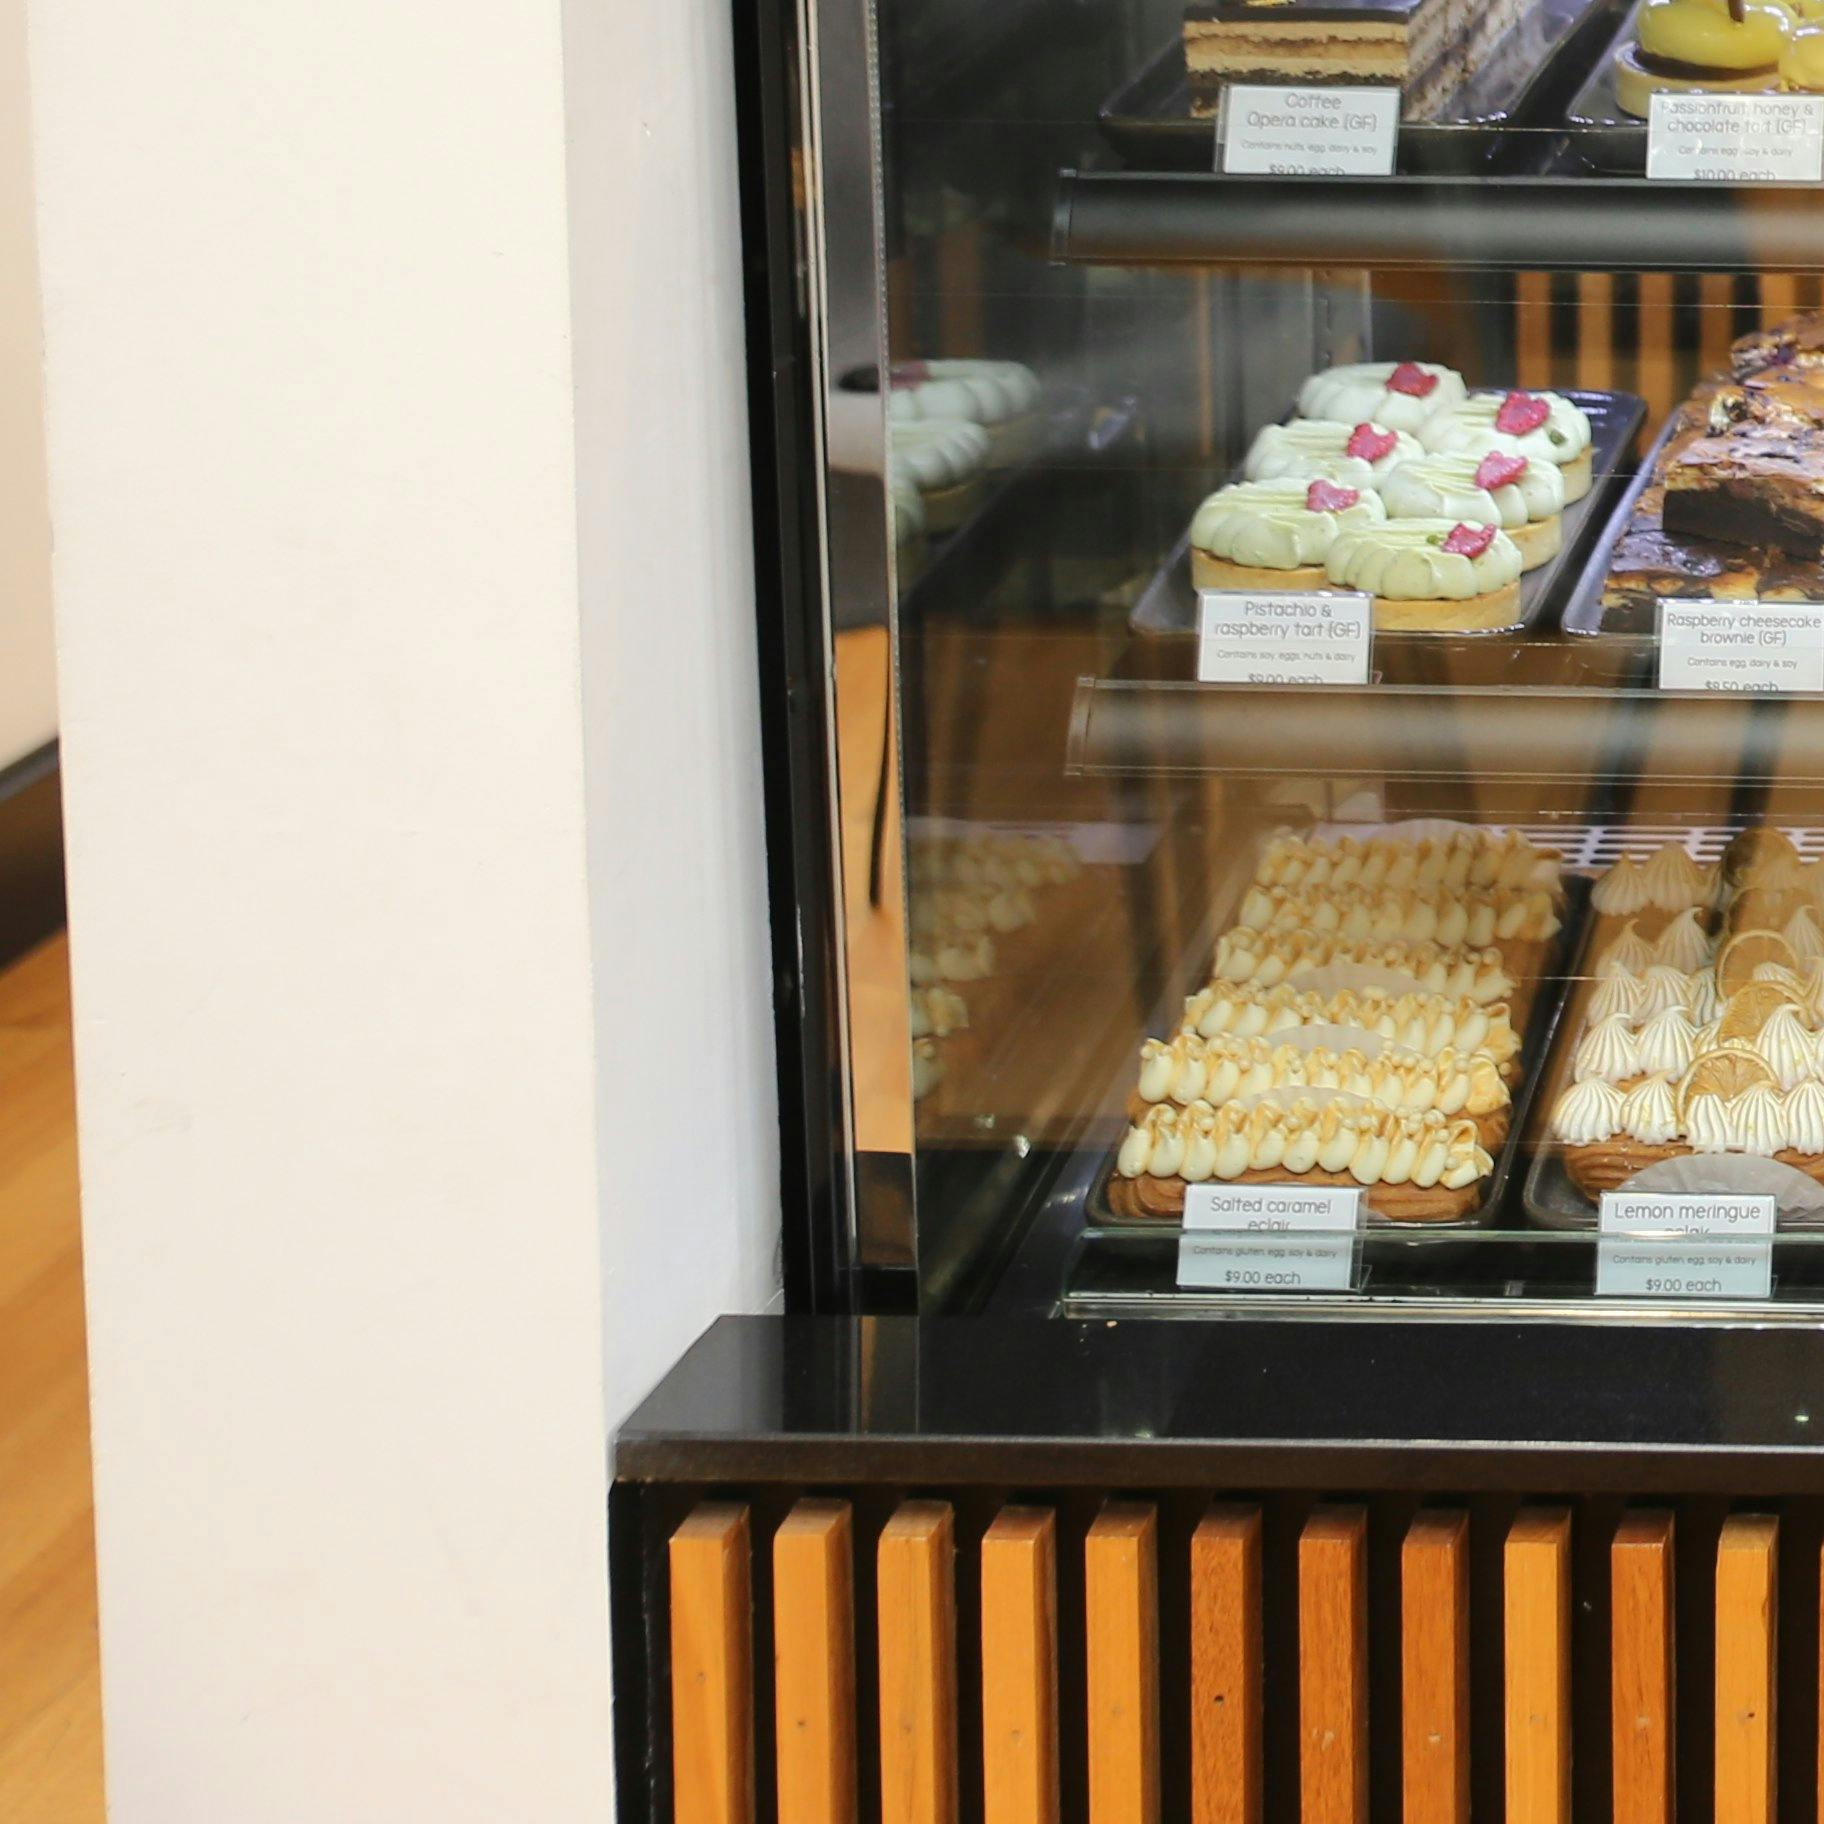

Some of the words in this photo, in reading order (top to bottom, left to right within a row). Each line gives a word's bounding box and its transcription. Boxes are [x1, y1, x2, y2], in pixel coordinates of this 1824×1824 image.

[1286, 92, 1342, 109] Coffee
[1248, 112, 1297, 130] Opera
[1301, 113, 1340, 129] cake
[1344, 112, 1378, 132] (GF)
[1667, 118, 1741, 134] chocolate
[1777, 118, 1808, 135] (GF)
[1245, 600, 1317, 618] Pistachio
[1321, 604, 1332, 617] &
[1216, 621, 1291, 640] raspberry
[1295, 620, 1325, 637] tart
[1328, 620, 1362, 640] (GF)
[1668, 612, 1735, 631] Raspberry
[1739, 614, 1823, 629] cheesecake
[1700, 630, 1755, 645] brownie
[1758, 629, 1787, 648] (GF)
[1210, 1196, 1263, 1212] Salted
[1266, 1198, 1332, 1214] caramel
[1615, 1202, 1674, 1219] Lemon
[1679, 1203, 1761, 1223] meringue
[1225, 1269, 1261, 1284] $9.00
[1265, 1270, 1302, 1285] each
[1646, 1278, 1682, 1293] $9.00
[1686, 1277, 1723, 1293] each
